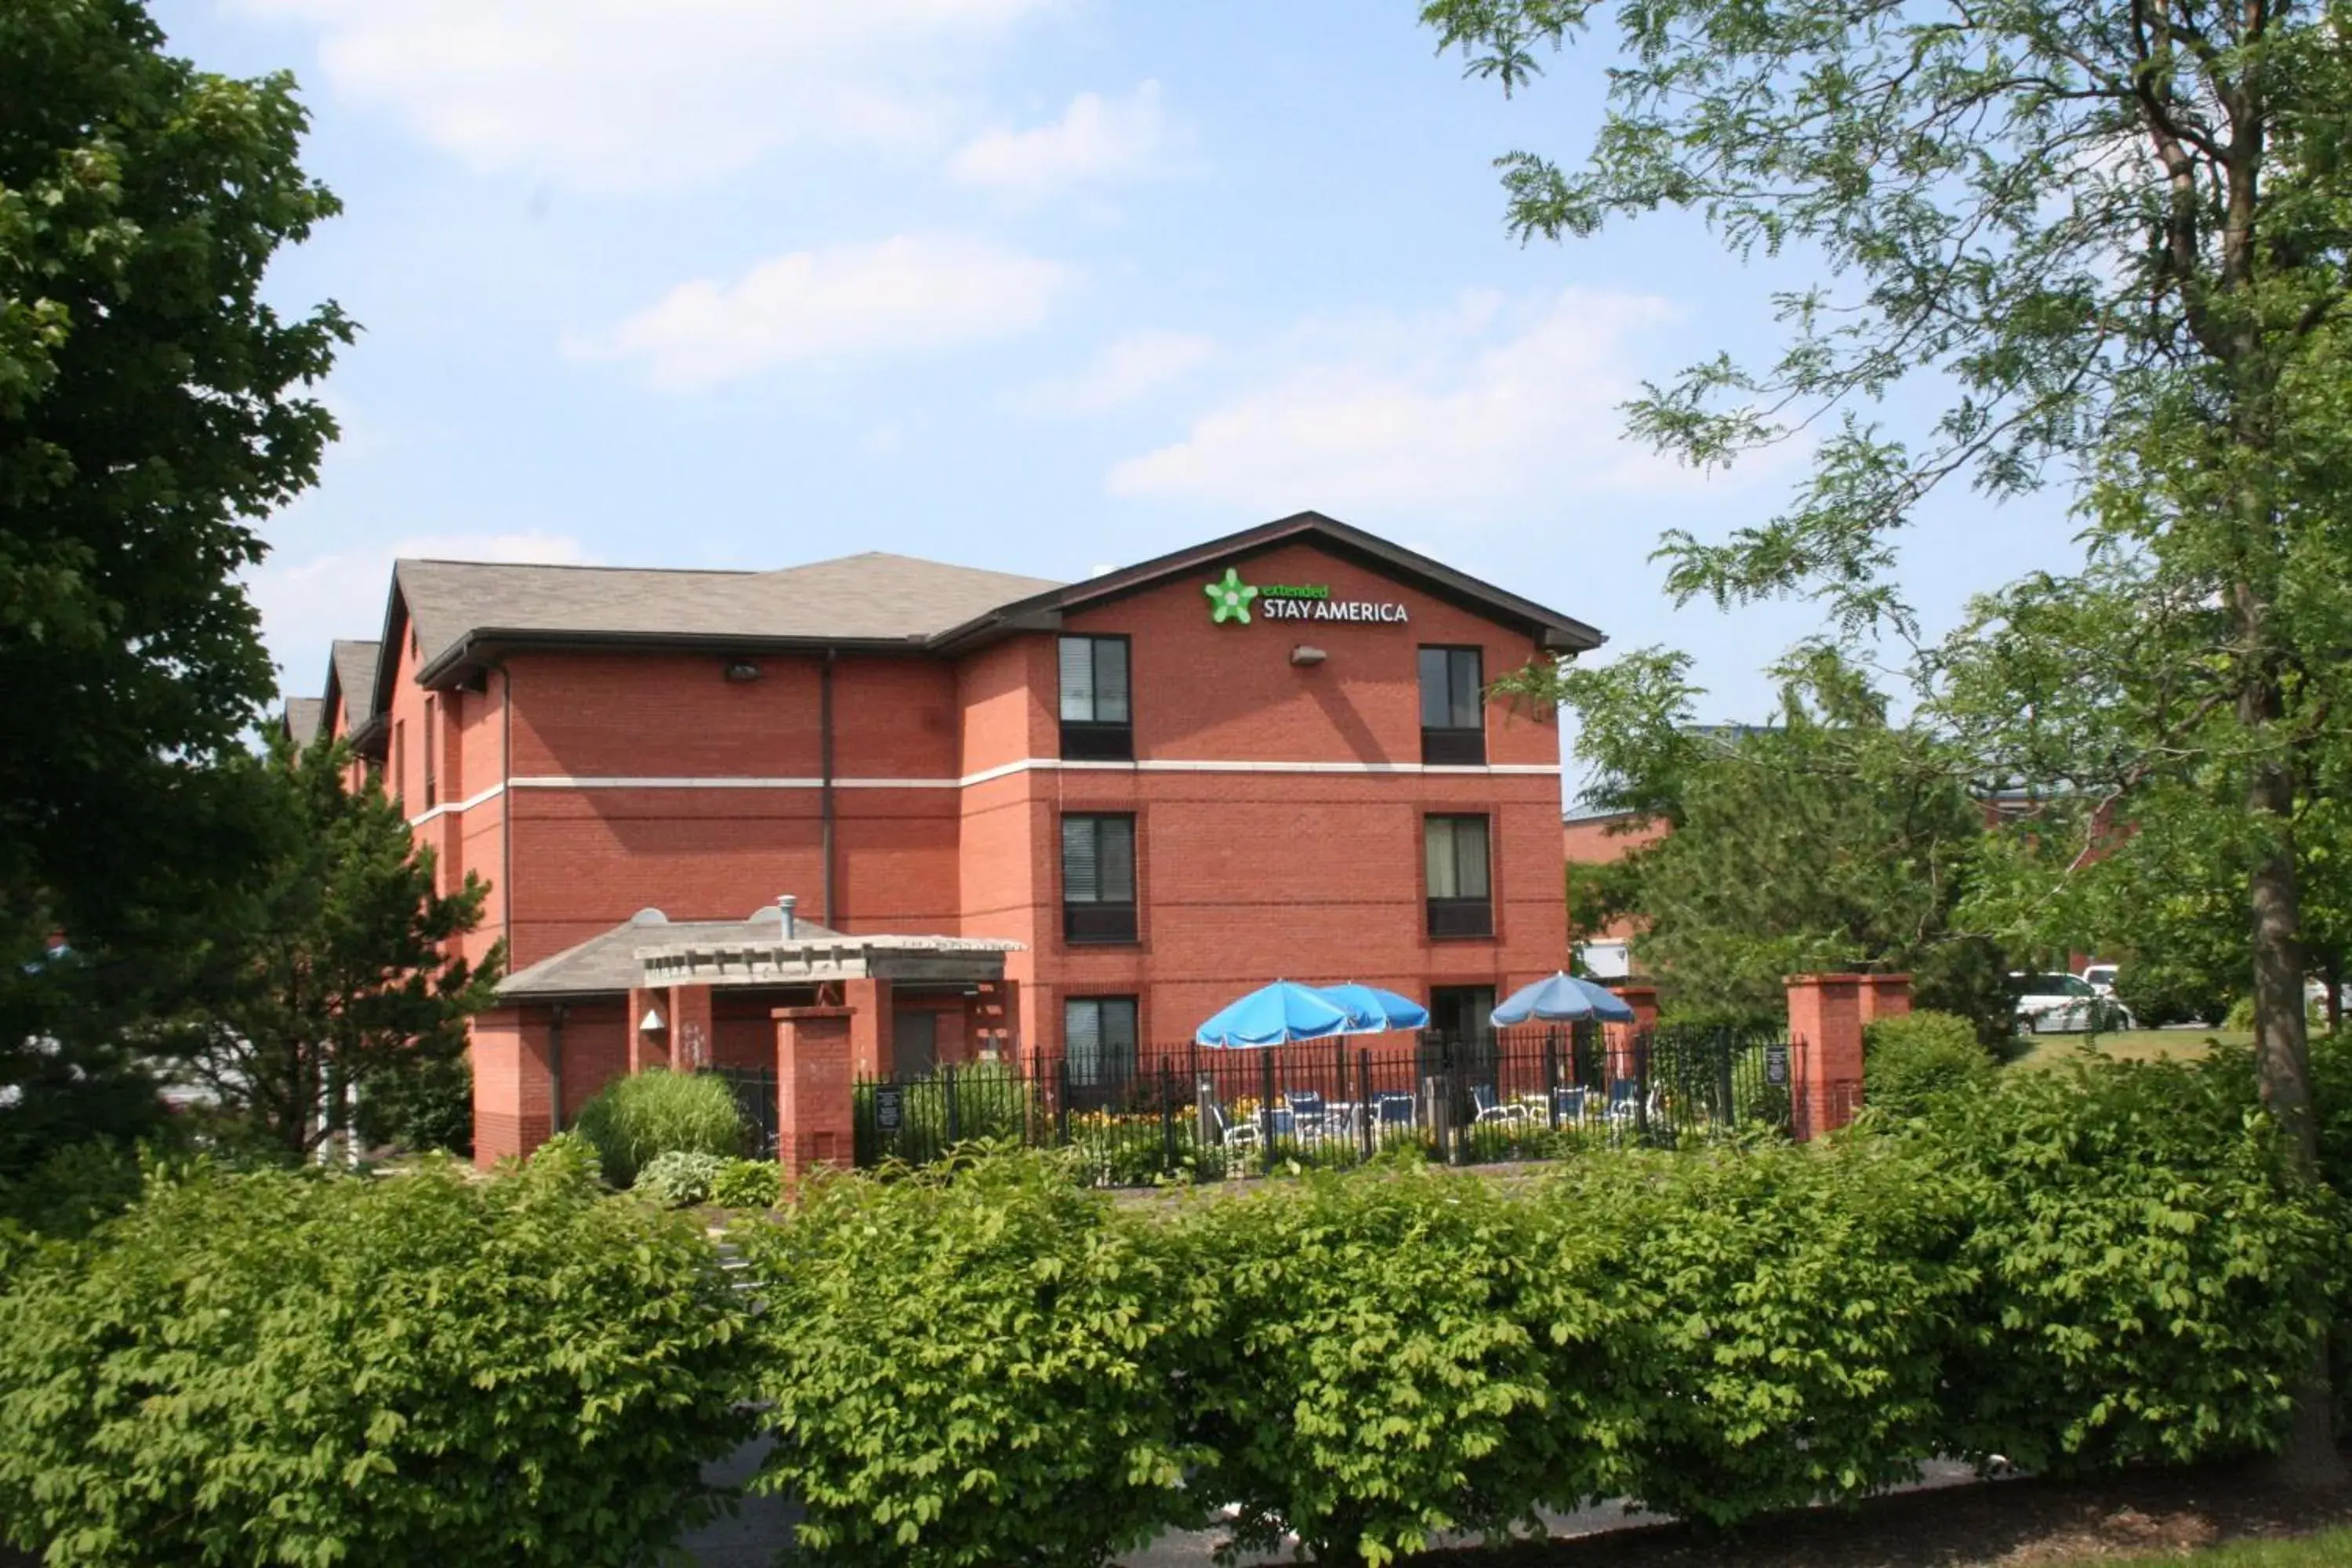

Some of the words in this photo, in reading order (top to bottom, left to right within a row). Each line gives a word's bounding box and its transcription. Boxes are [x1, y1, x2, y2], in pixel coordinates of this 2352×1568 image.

[1262, 584, 1328, 598] extended
[1264, 599, 1313, 619] STAY
[1315, 601, 1408, 622] AMERICA
